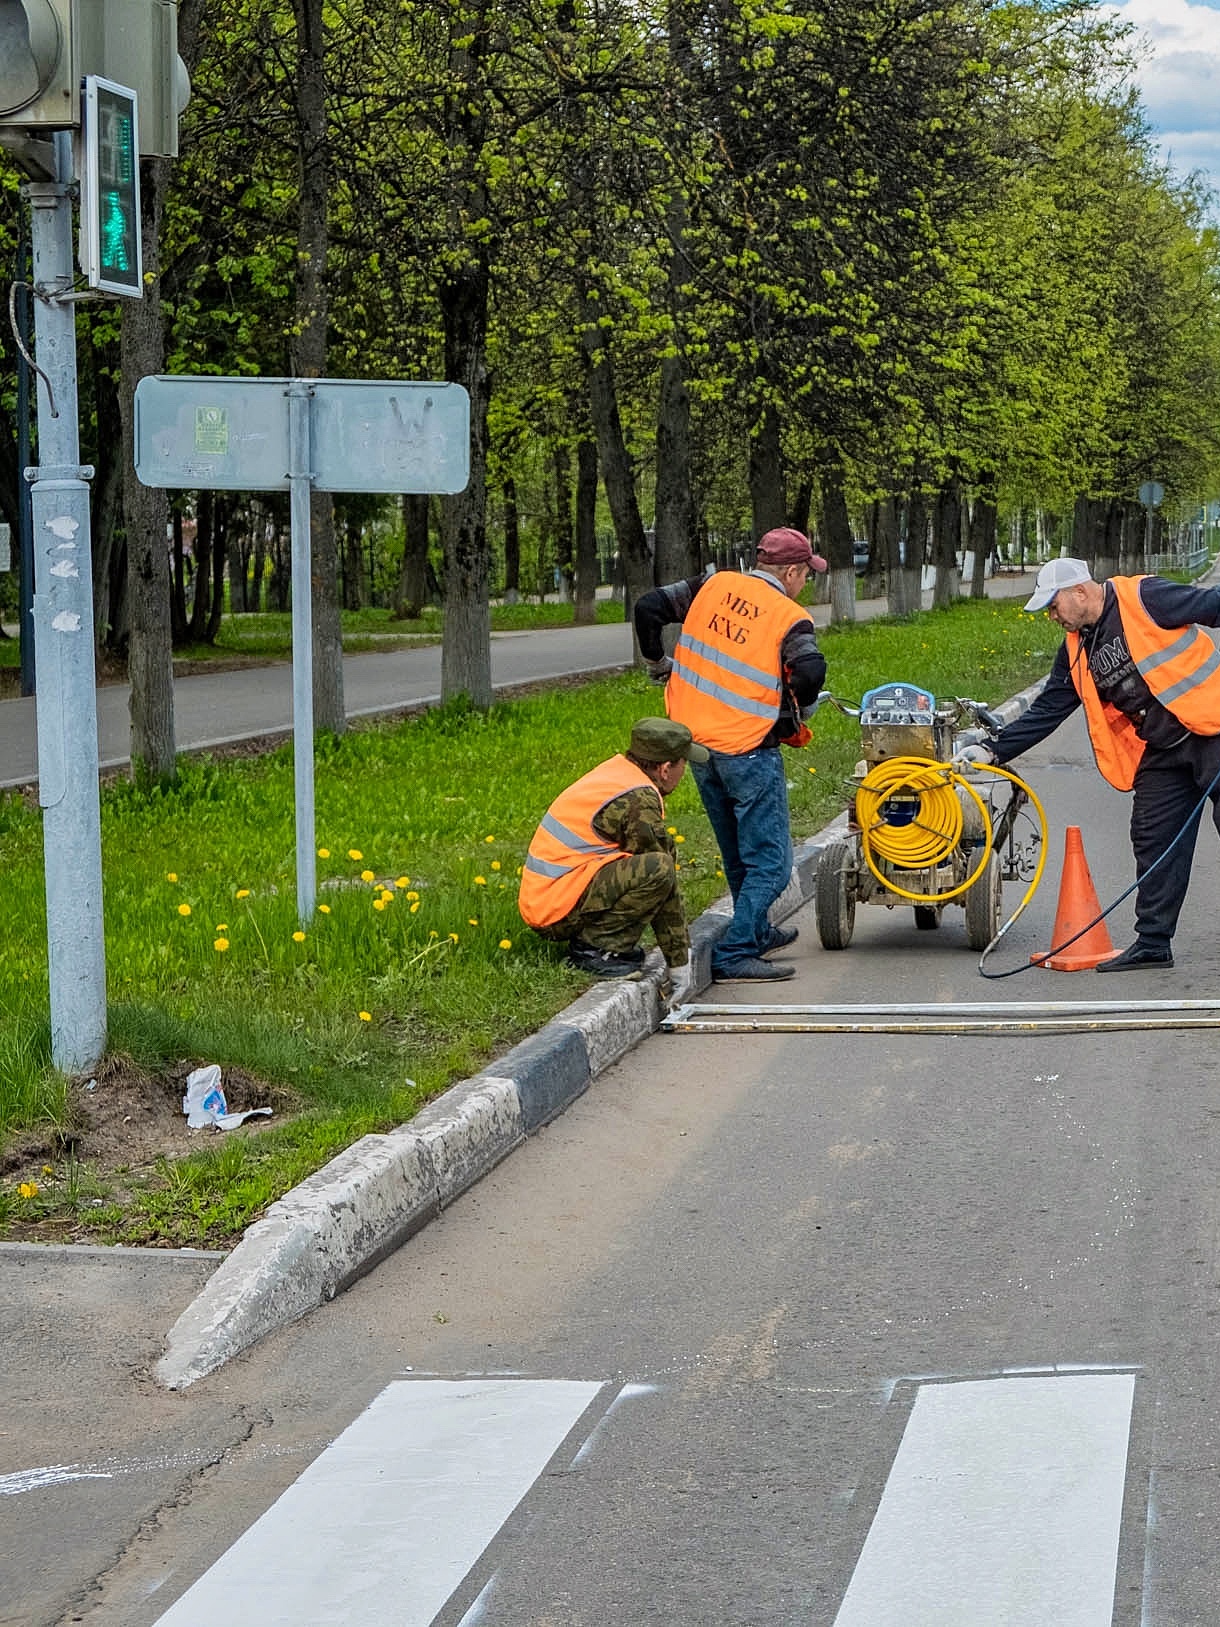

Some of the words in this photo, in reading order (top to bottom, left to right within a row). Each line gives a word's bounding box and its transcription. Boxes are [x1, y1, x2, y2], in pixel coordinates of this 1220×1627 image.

[720, 592, 767, 620] МБУ
[708, 613, 749, 645] КХБ
[1090, 634, 1130, 682] PUM
